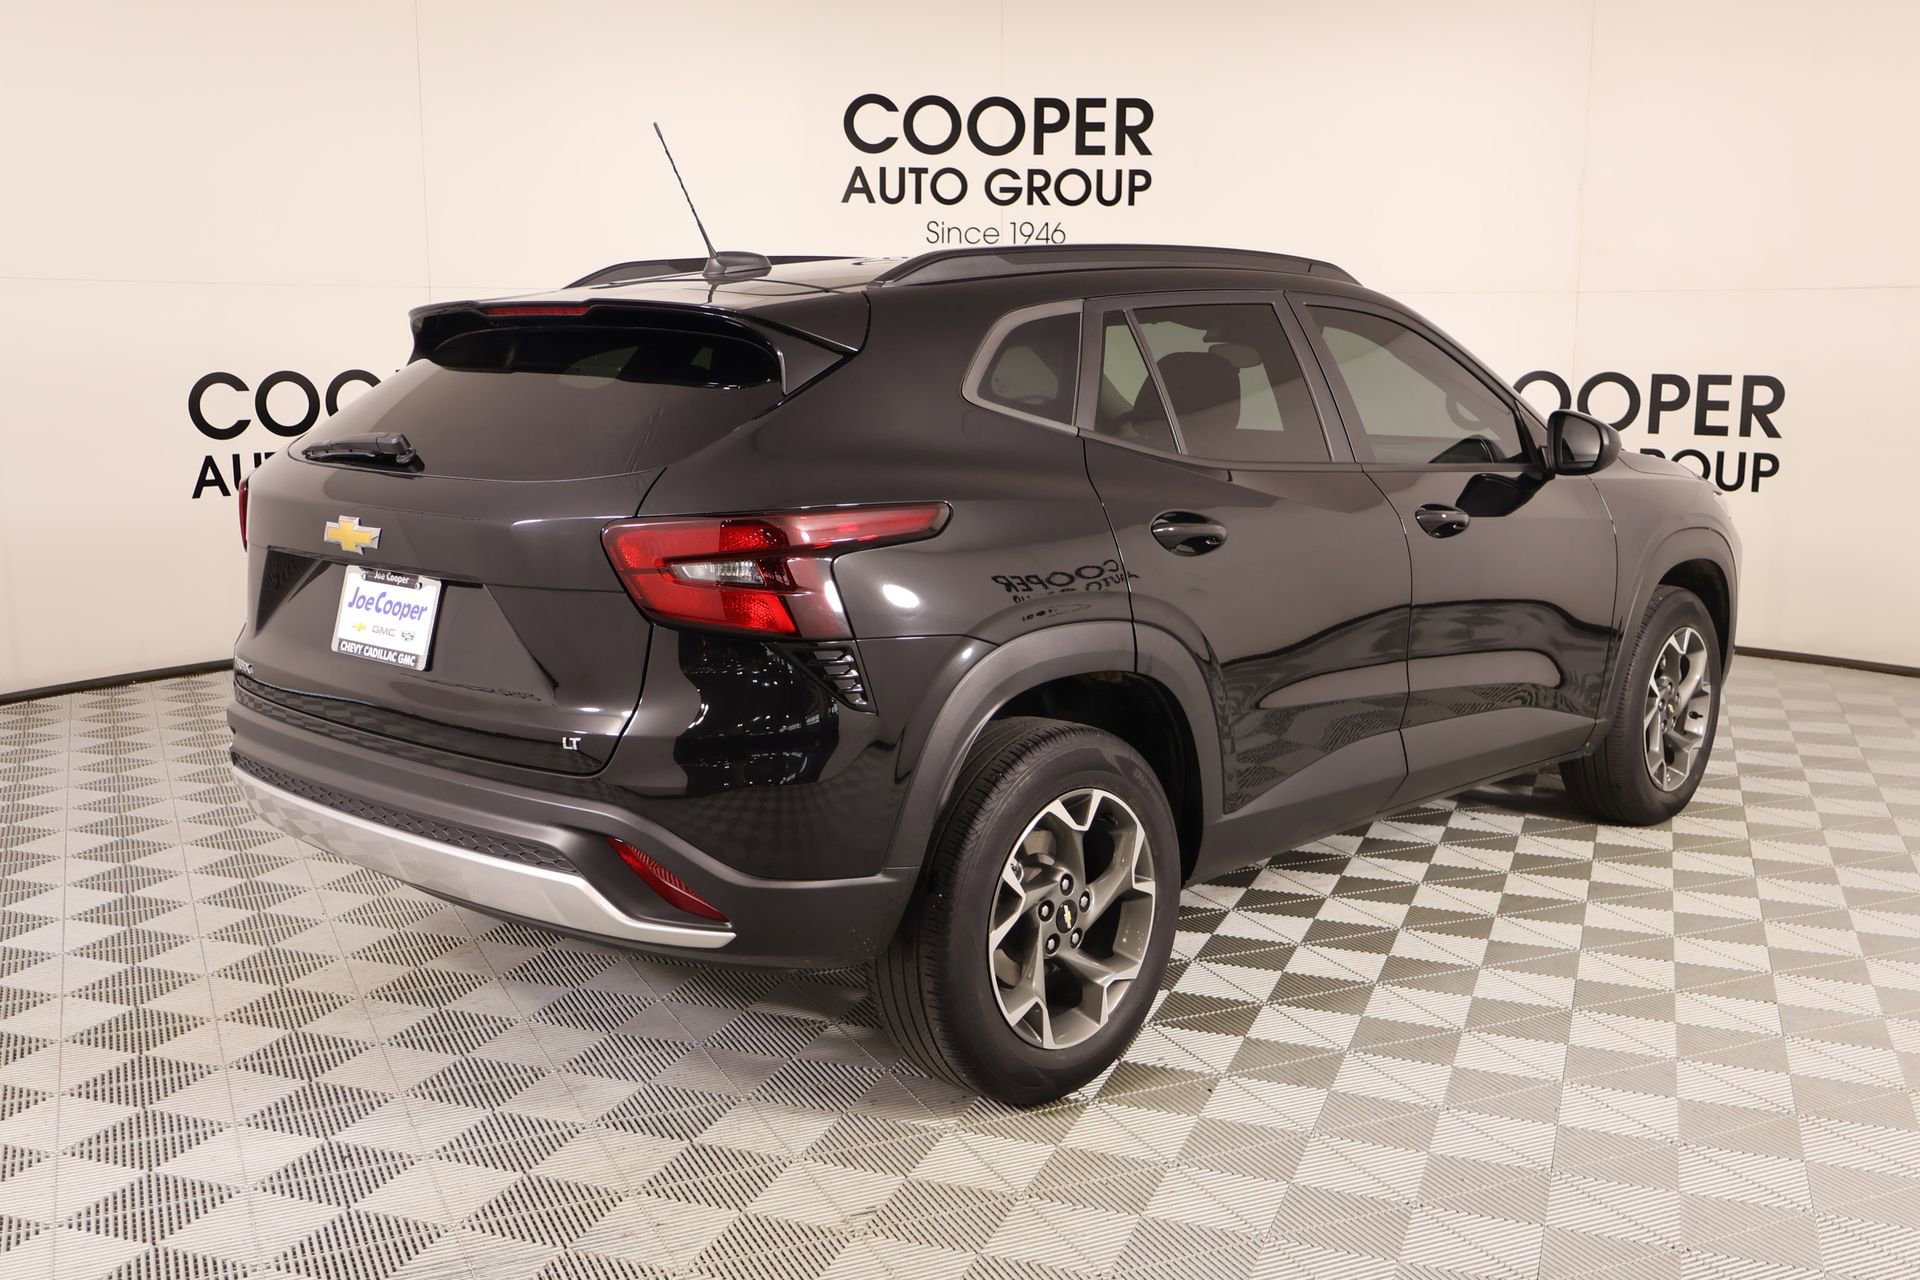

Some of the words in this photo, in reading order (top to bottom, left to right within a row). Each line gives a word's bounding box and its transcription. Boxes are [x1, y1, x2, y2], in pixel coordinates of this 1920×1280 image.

[843, 93, 1154, 156] COOPER
[841, 166, 968, 206] AUTO
[984, 168, 1152, 207] GROUP
[925, 220, 1000, 244] Since
[1010, 221, 1067, 245] 1946
[188, 369, 383, 440] COO
[1513, 370, 1786, 439] OOPER
[374, 570, 385, 580] Joe
[386, 572, 409, 584] Cooper
[372, 625, 397, 637] GMC
[341, 641, 363, 654] CHEVY
[364, 647, 397, 662] CADILLAC
[398, 654, 415, 666] GMC
[562, 736, 582, 751] LT
